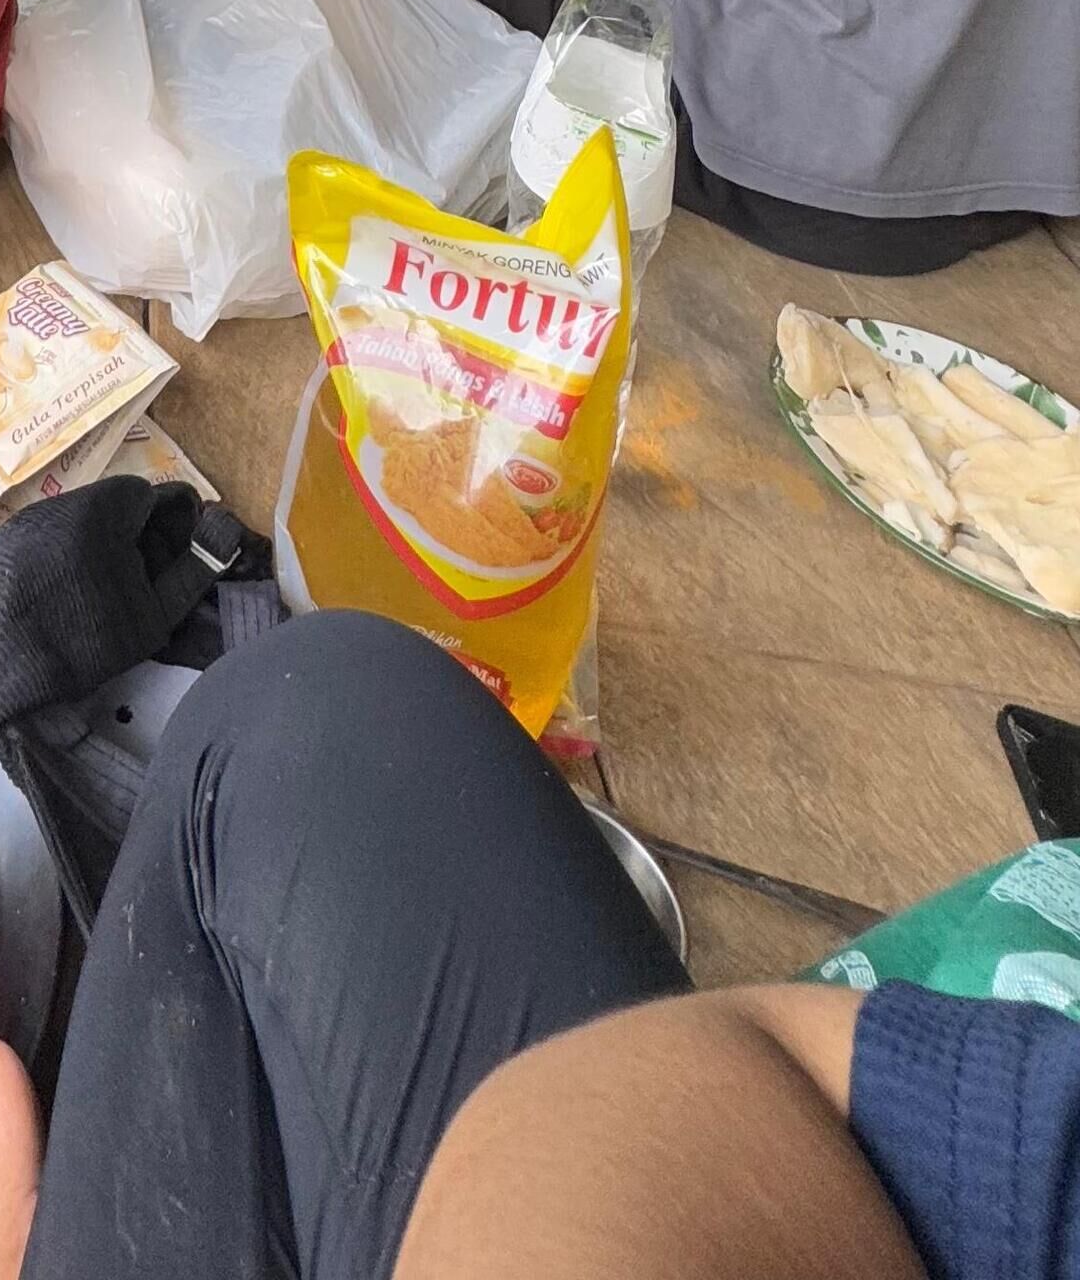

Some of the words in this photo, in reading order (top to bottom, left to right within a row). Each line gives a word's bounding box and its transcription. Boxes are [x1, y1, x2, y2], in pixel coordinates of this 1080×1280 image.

[421, 236, 488, 262] MINYAK
[493, 254, 572, 280] GORENG
[7, 296, 60, 341] Latte
[16, 276, 91, 337] Creamy
[11, 411, 50, 444] Gula
[52, 355, 125, 410] Terpisah
